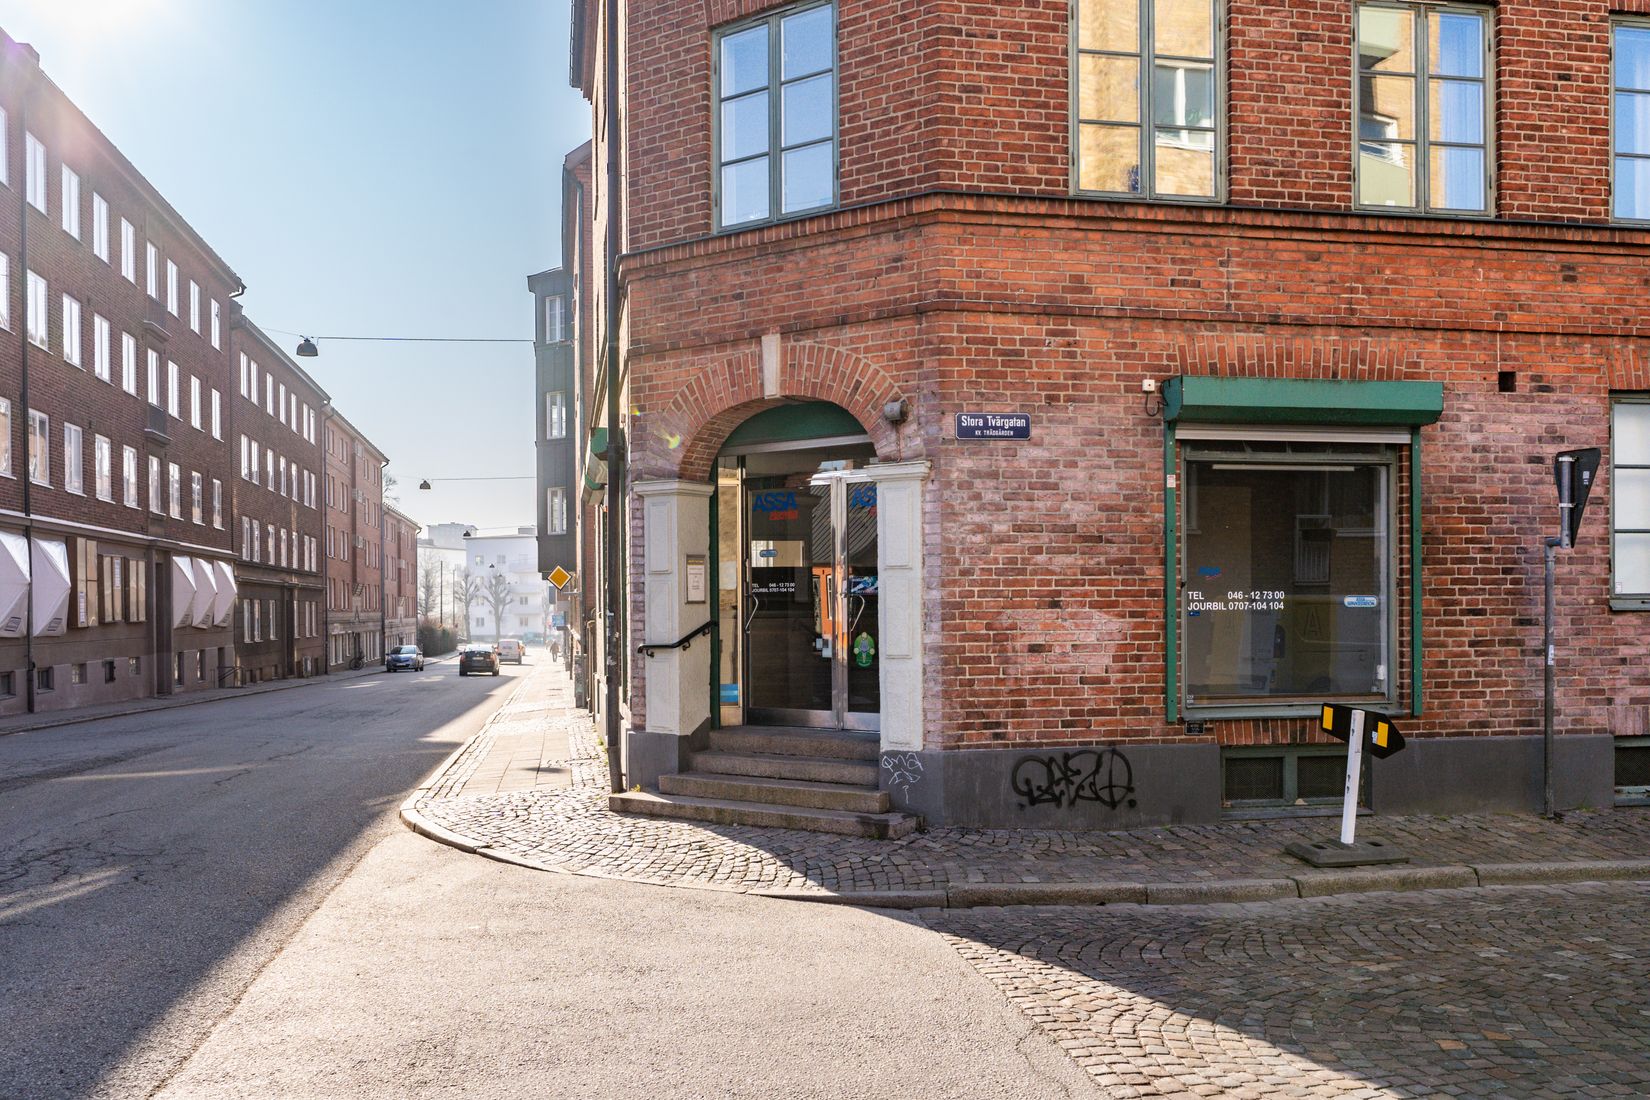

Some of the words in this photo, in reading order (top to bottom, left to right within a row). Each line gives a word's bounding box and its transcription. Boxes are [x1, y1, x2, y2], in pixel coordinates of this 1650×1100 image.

[961, 415, 983, 427] Stora
[986, 415, 1026, 429] Tvärgatan
[752, 491, 797, 512] ASSA
[1188, 591, 1205, 600] TEL
[1227, 591, 1243, 600] 046
[1250, 591, 1260, 600] 12
[1262, 591, 1273, 600] 73
[1274, 590, 1285, 599] 00
[1187, 601, 1227, 611] JOURBIL
[1228, 601, 1267, 610] 0707-104
[1269, 601, 1284, 610] 104
